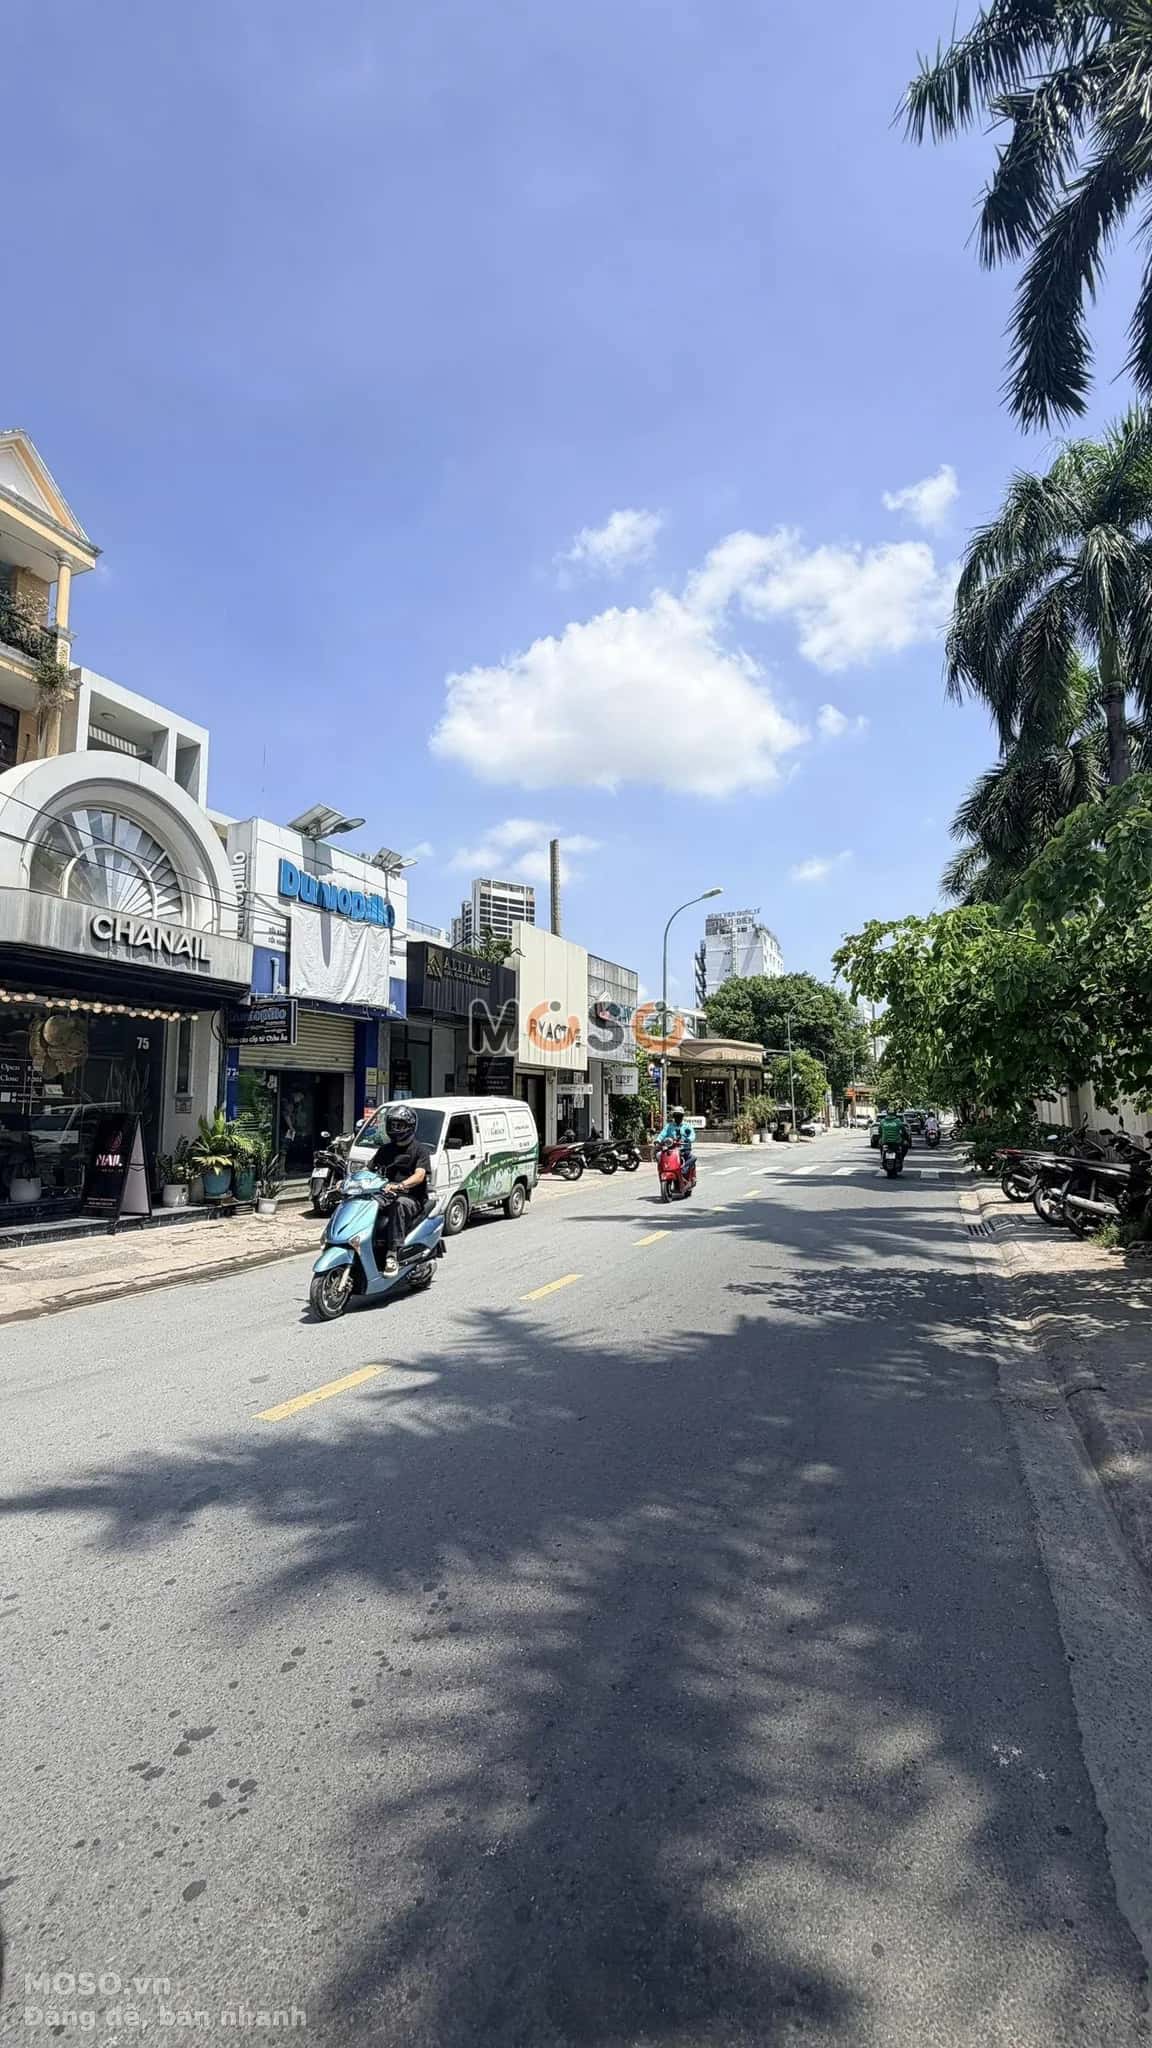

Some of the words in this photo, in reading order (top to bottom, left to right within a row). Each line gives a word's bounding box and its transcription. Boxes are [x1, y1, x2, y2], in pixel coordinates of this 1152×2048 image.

[278, 857, 395, 929] Dunlopillo
[91, 914, 213, 962] CHANAIL
[136, 1036, 150, 1050] 75
